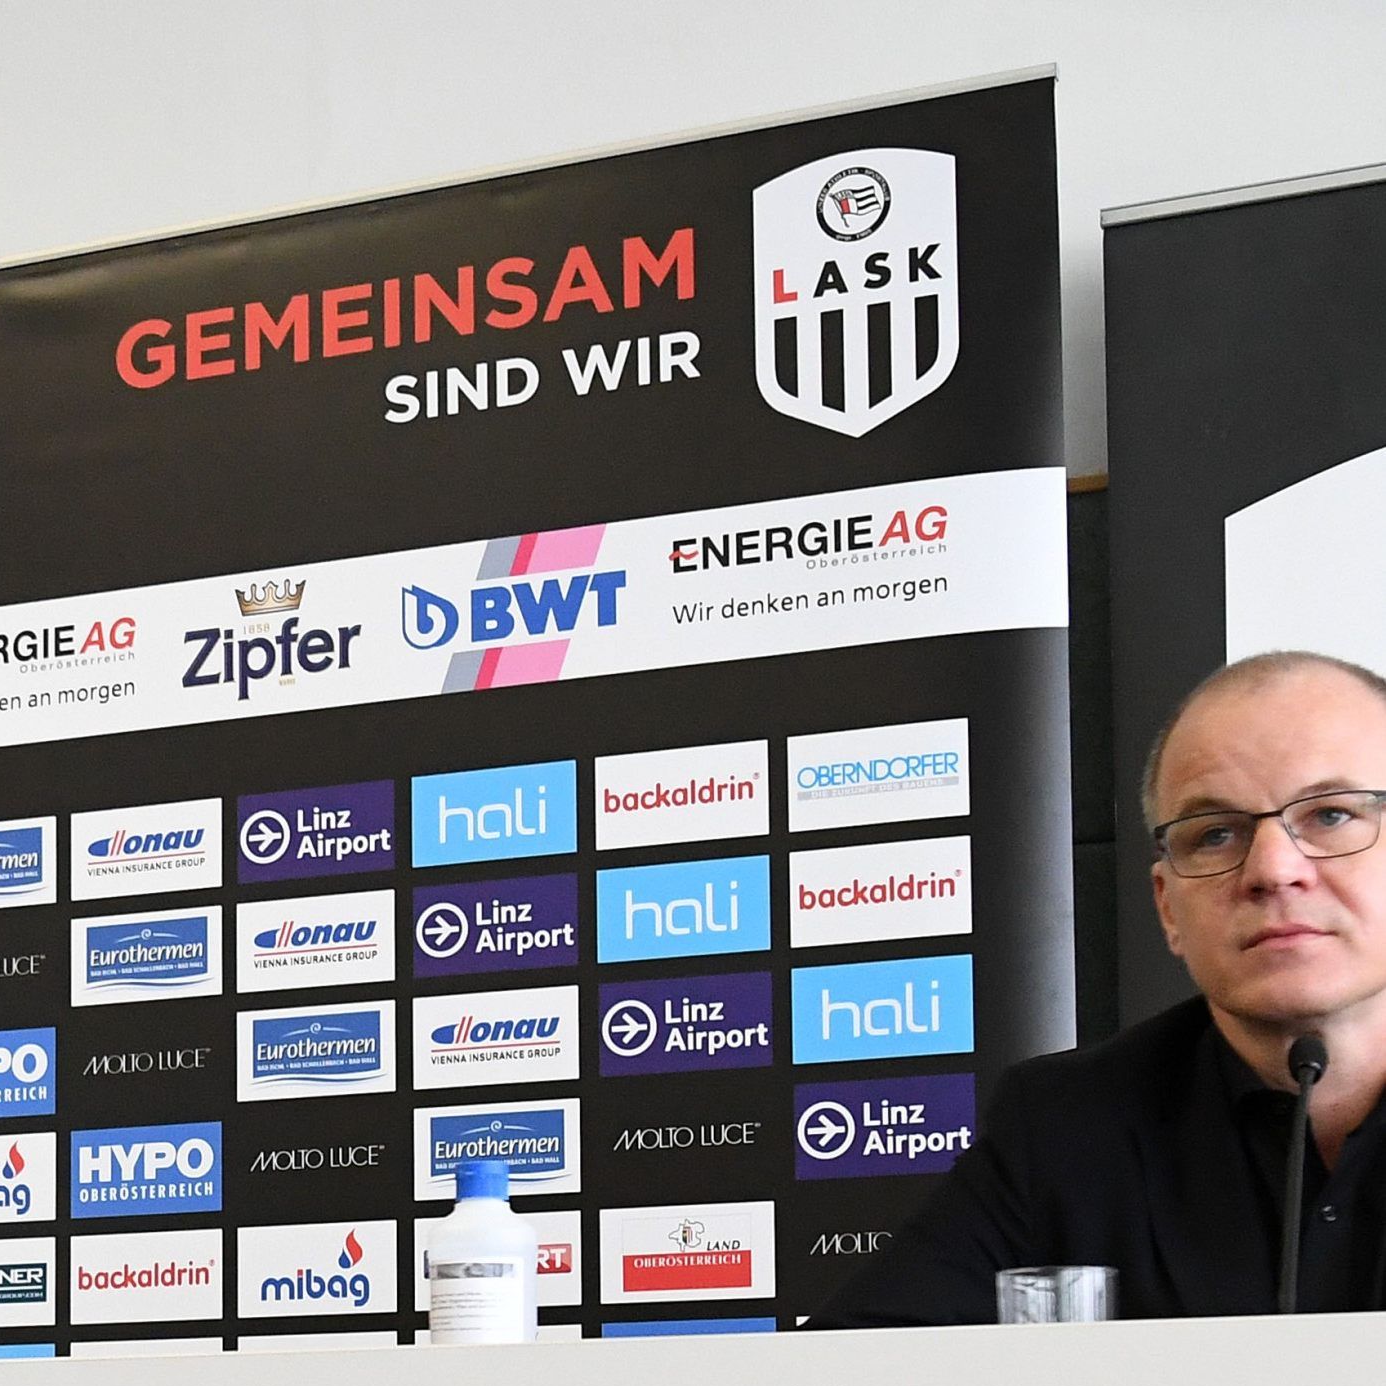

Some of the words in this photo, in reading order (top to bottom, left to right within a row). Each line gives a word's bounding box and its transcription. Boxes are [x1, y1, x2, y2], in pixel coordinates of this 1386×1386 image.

[773, 243, 942, 304] LASK
[114, 226, 697, 389] GEMEINSAM
[384, 356, 540, 424] SIND
[561, 330, 702, 395] WIR
[669, 514, 874, 574] ENERGIE
[878, 505, 948, 547] AG
[806, 543, 947, 570] Oberösterreich
[470, 570, 627, 643] BWT
[672, 603, 714, 625] Wir
[721, 593, 809, 619] denken
[817, 589, 845, 607] an
[853, 576, 948, 601] morgen
[79, 616, 137, 655] AG
[19, 651, 136, 674] Oberösterreich
[182, 616, 362, 701] Zipfer
[28, 691, 51, 707] an
[58, 681, 136, 704] morgen
[797, 752, 959, 789] OBERNDORFER
[603, 775, 754, 814] backaldrin
[296, 806, 352, 833] Linz
[438, 785, 548, 845] hali
[296, 828, 392, 861] Airport
[87, 867, 120, 877] VIENNA
[122, 860, 173, 873] INSURANCE
[175, 857, 206, 868] GROUP
[798, 872, 956, 911] backaldrin
[475, 899, 533, 926] Linz
[625, 880, 739, 940] hali
[90, 941, 203, 967] Eurothermen
[475, 923, 575, 956] Airport
[254, 958, 288, 969] VIENNA
[290, 953, 343, 966] INSURANCE
[346, 950, 378, 961] GROUP
[664, 997, 725, 1025] Linz
[821, 980, 940, 1040] hali
[257, 1037, 375, 1061] Eurothermen
[664, 1021, 769, 1056] Airport
[83, 1052, 154, 1076] MOLTO
[159, 1048, 206, 1071] LUCE
[431, 1054, 466, 1065] VIENNA
[469, 1049, 524, 1062] INSURANCE
[527, 1047, 561, 1058] GROUP
[861, 1099, 926, 1127] Linz
[435, 1135, 559, 1159] Eurothermen
[613, 1126, 694, 1151] MOLTO
[701, 1122, 755, 1146] LUCE
[861, 1125, 972, 1159] Airport
[79, 1137, 214, 1184] HYPO
[250, 1148, 324, 1172] MOLTO
[329, 1145, 379, 1168] LUCE
[79, 1181, 214, 1203] OBERÖSTERREICH
[706, 1240, 741, 1251] LAND
[77, 1261, 209, 1292] backaldrin
[261, 1268, 370, 1307] mibag
